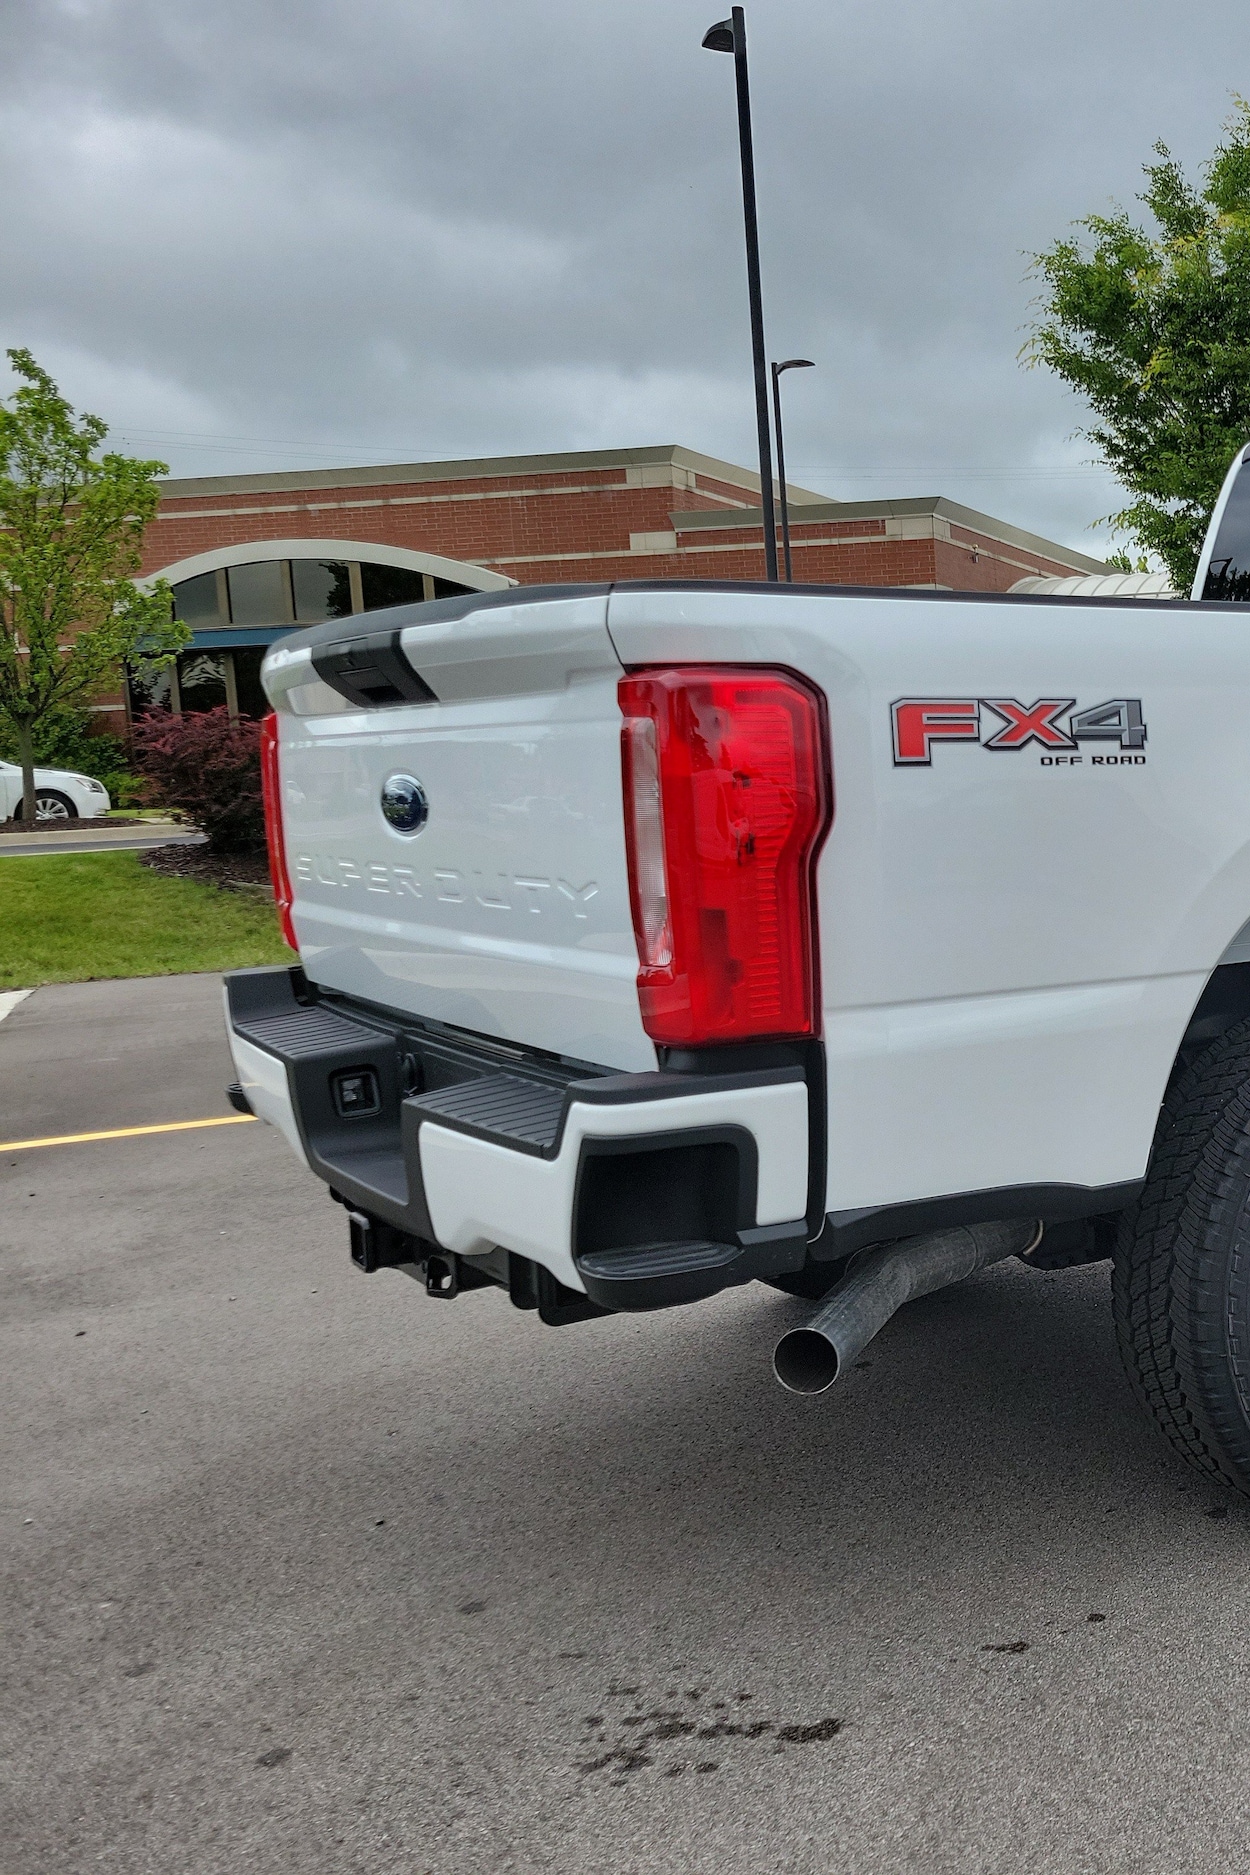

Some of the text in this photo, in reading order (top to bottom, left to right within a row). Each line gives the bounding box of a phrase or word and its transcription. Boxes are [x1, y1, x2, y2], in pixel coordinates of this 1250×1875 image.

[890, 697, 1148, 768] FX4
[1040, 755, 1146, 766] OFF ROAD
[295, 851, 600, 919] SUPER DUTY
